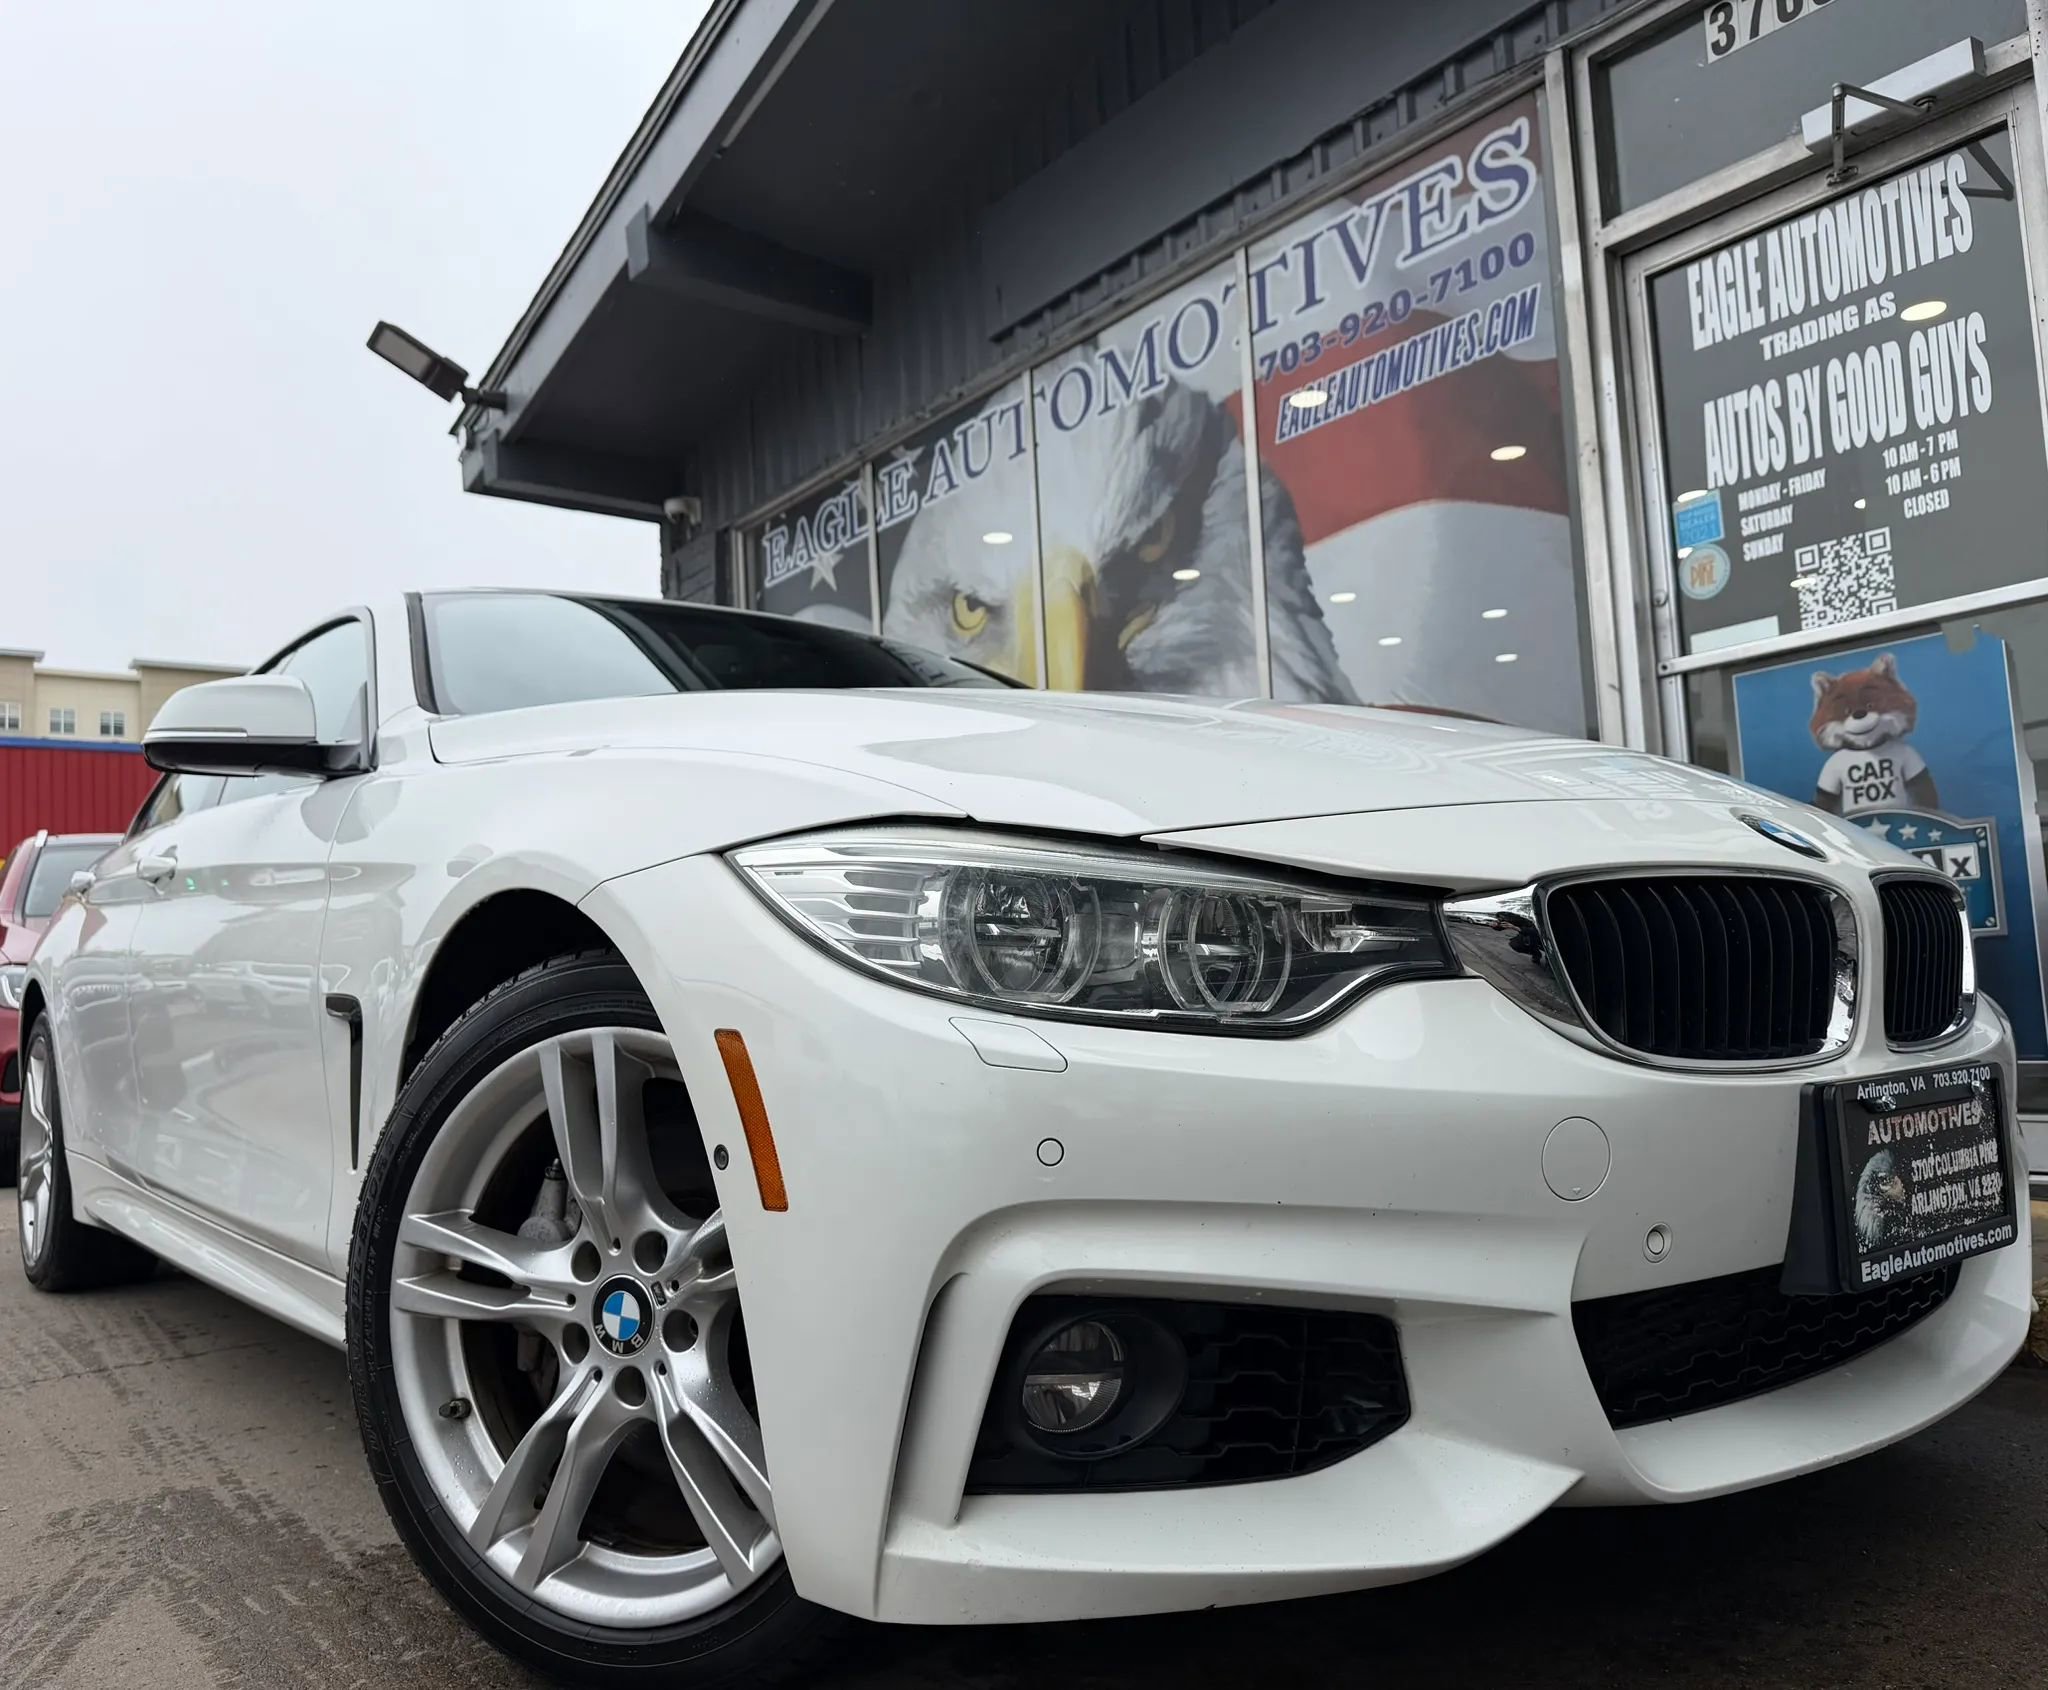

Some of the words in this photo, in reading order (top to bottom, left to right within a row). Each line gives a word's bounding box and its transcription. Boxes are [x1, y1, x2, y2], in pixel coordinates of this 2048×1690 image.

[1687, 238, 1766, 351] EAGLE
[1766, 153, 1974, 322] AUTOMOTIVES
[1259, 231, 1536, 384] 703-920-7100
[1759, 304, 1859, 361] TRADING
[1864, 291, 1897, 325] AS
[763, 457, 918, 587] EAGLE
[922, 116, 1537, 508] AUTOMOTIVES
[1275, 284, 1541, 445] EAGLEAUTOMOTIVES.COM
[1704, 378, 1787, 490] AUTOS
[1786, 364, 1823, 465] BY
[1826, 340, 1907, 454] GOOD
[1908, 311, 1992, 430] GUYS
[1882, 447, 1898, 469] 10
[1899, 440, 1919, 465] AM
[1926, 435, 1934, 457] 7
[1938, 428, 1959, 453] PM
[1738, 481, 1781, 512] MONDAY
[1788, 467, 1826, 497] FRIDAY
[1885, 473, 1901, 496] 10
[1902, 467, 1922, 492] AM
[1930, 462, 1940, 484] 6
[1941, 456, 1961, 480] PM
[1740, 503, 1793, 537] SATURDAY
[1903, 488, 1950, 519] CLOSED
[1743, 532, 1784, 562] SUNDAY
[1848, 759, 1894, 784] CAR
[1853, 779, 1896, 805] FOX
[1857, 1081, 1909, 1100] Arlington,
[1910, 1076, 1926, 1092] VA
[1933, 1066, 1990, 1089] 703.920.7100
[1868, 1100, 1981, 1145] AUTOMOTIVES
[1861, 1224, 2012, 1283] EagleAutomotives.com
[595, 1324, 644, 1354] BMW
